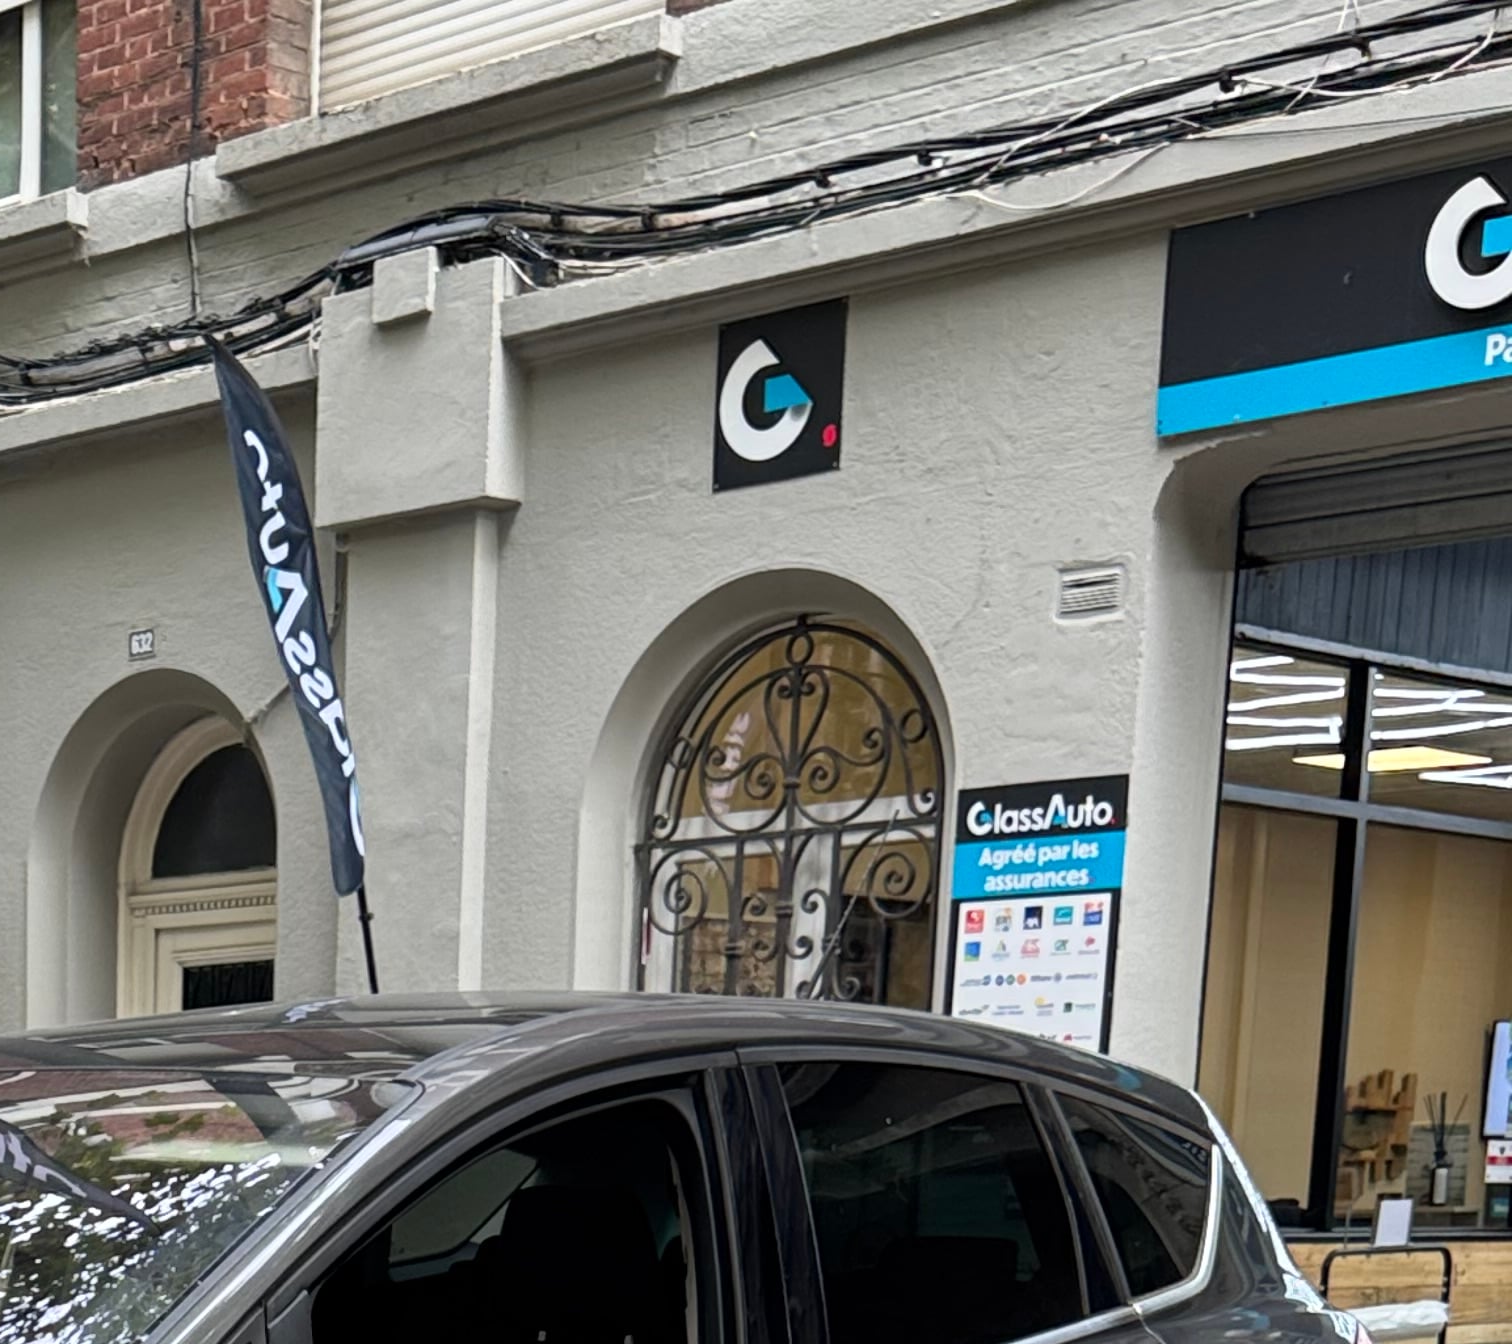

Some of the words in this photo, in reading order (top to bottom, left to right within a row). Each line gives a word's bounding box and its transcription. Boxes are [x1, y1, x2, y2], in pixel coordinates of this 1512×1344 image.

[977, 842, 1037, 871] Agréé
[1037, 844, 1071, 868] par
[1072, 839, 1100, 860] les
[983, 867, 1091, 893] assurances
